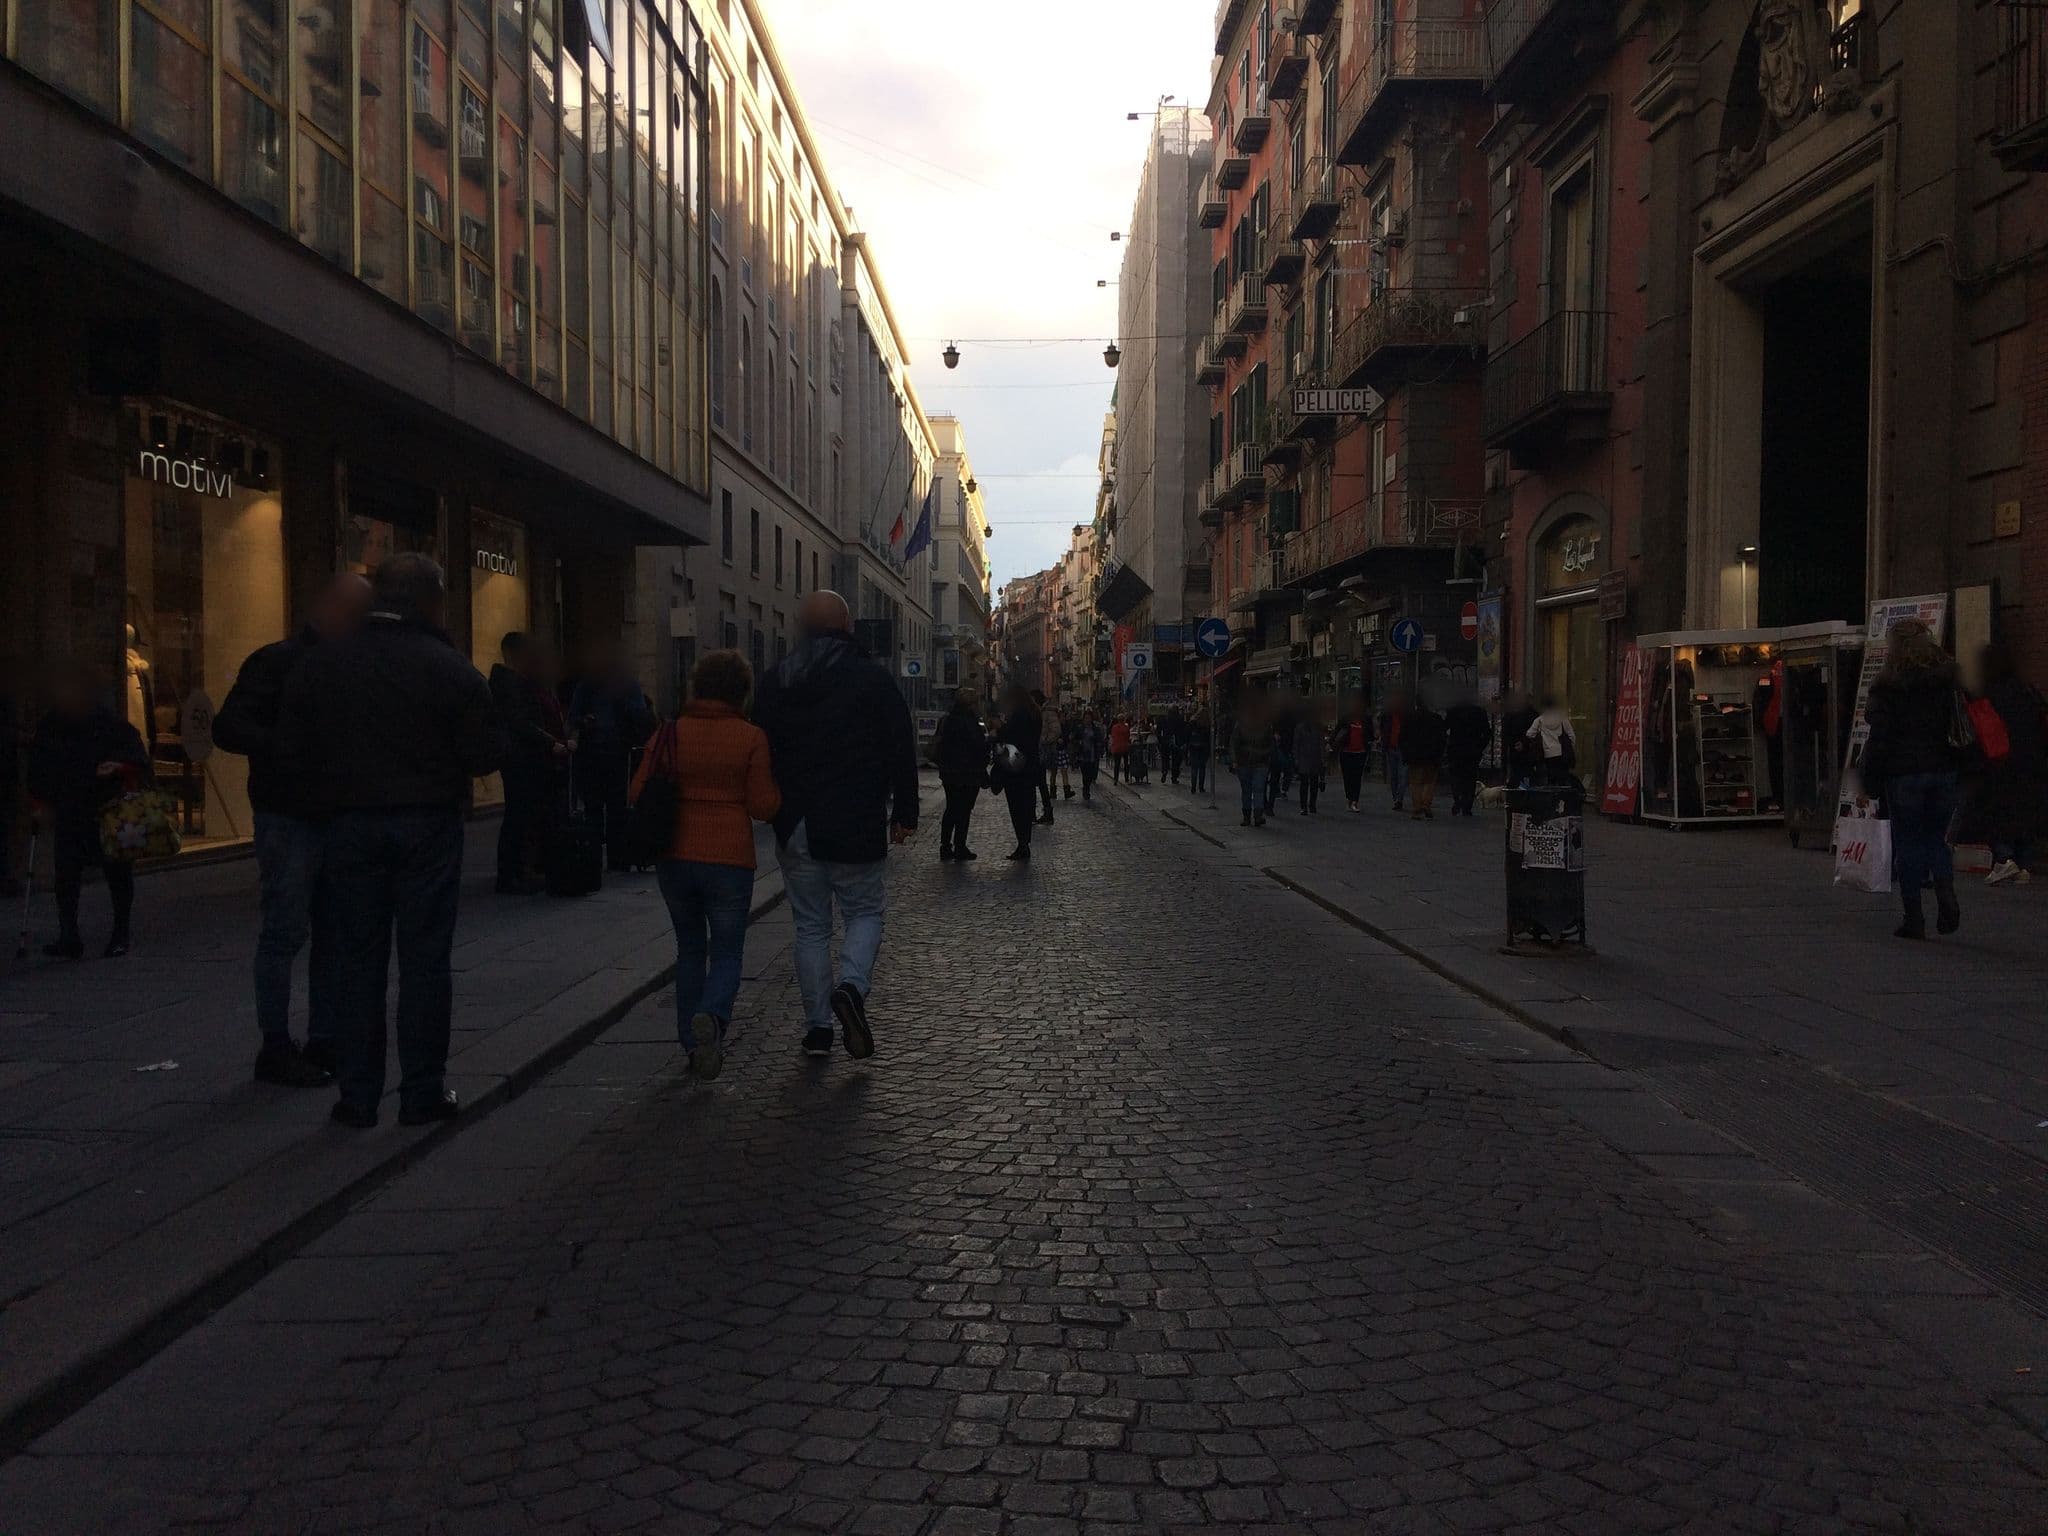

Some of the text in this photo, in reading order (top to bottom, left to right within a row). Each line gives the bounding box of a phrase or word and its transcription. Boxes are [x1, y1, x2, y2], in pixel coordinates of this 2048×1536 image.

[1296, 391, 1371, 411] PELLICCE
[140, 450, 232, 499] motivi
[477, 550, 518, 576] motivi
[1617, 727, 1640, 745] SALE
